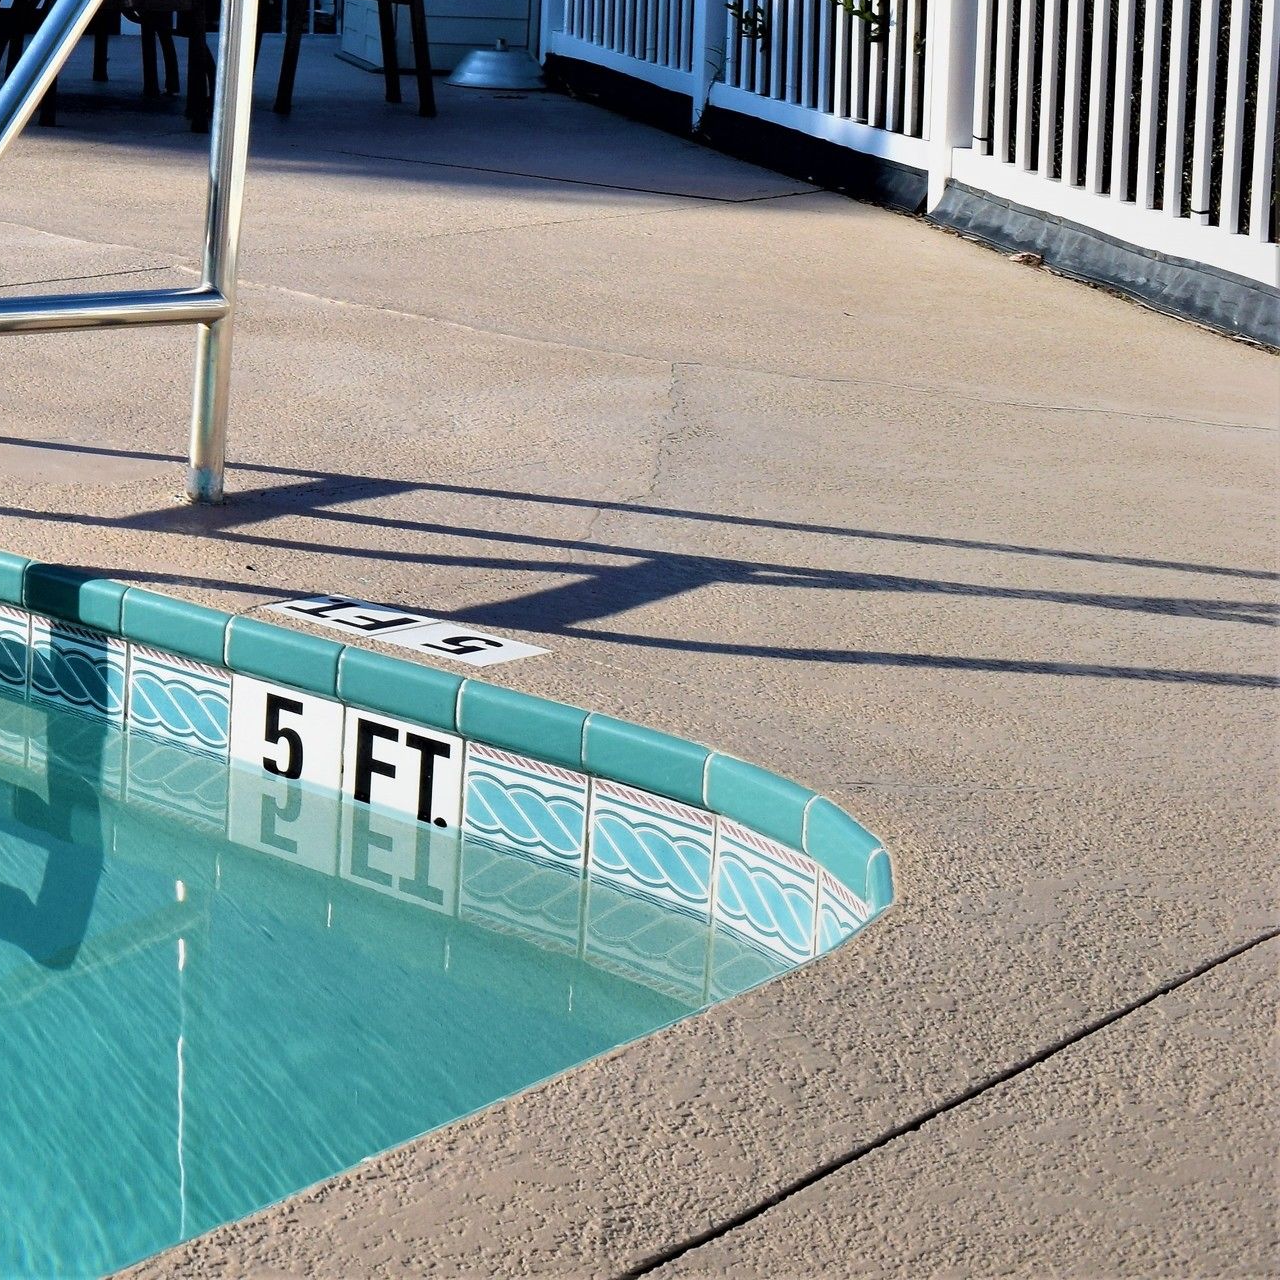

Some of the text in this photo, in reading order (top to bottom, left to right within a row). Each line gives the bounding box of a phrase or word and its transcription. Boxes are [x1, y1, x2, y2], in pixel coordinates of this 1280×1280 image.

[423, 636, 503, 656] 5
[262, 692, 451, 829] 5 FT.
